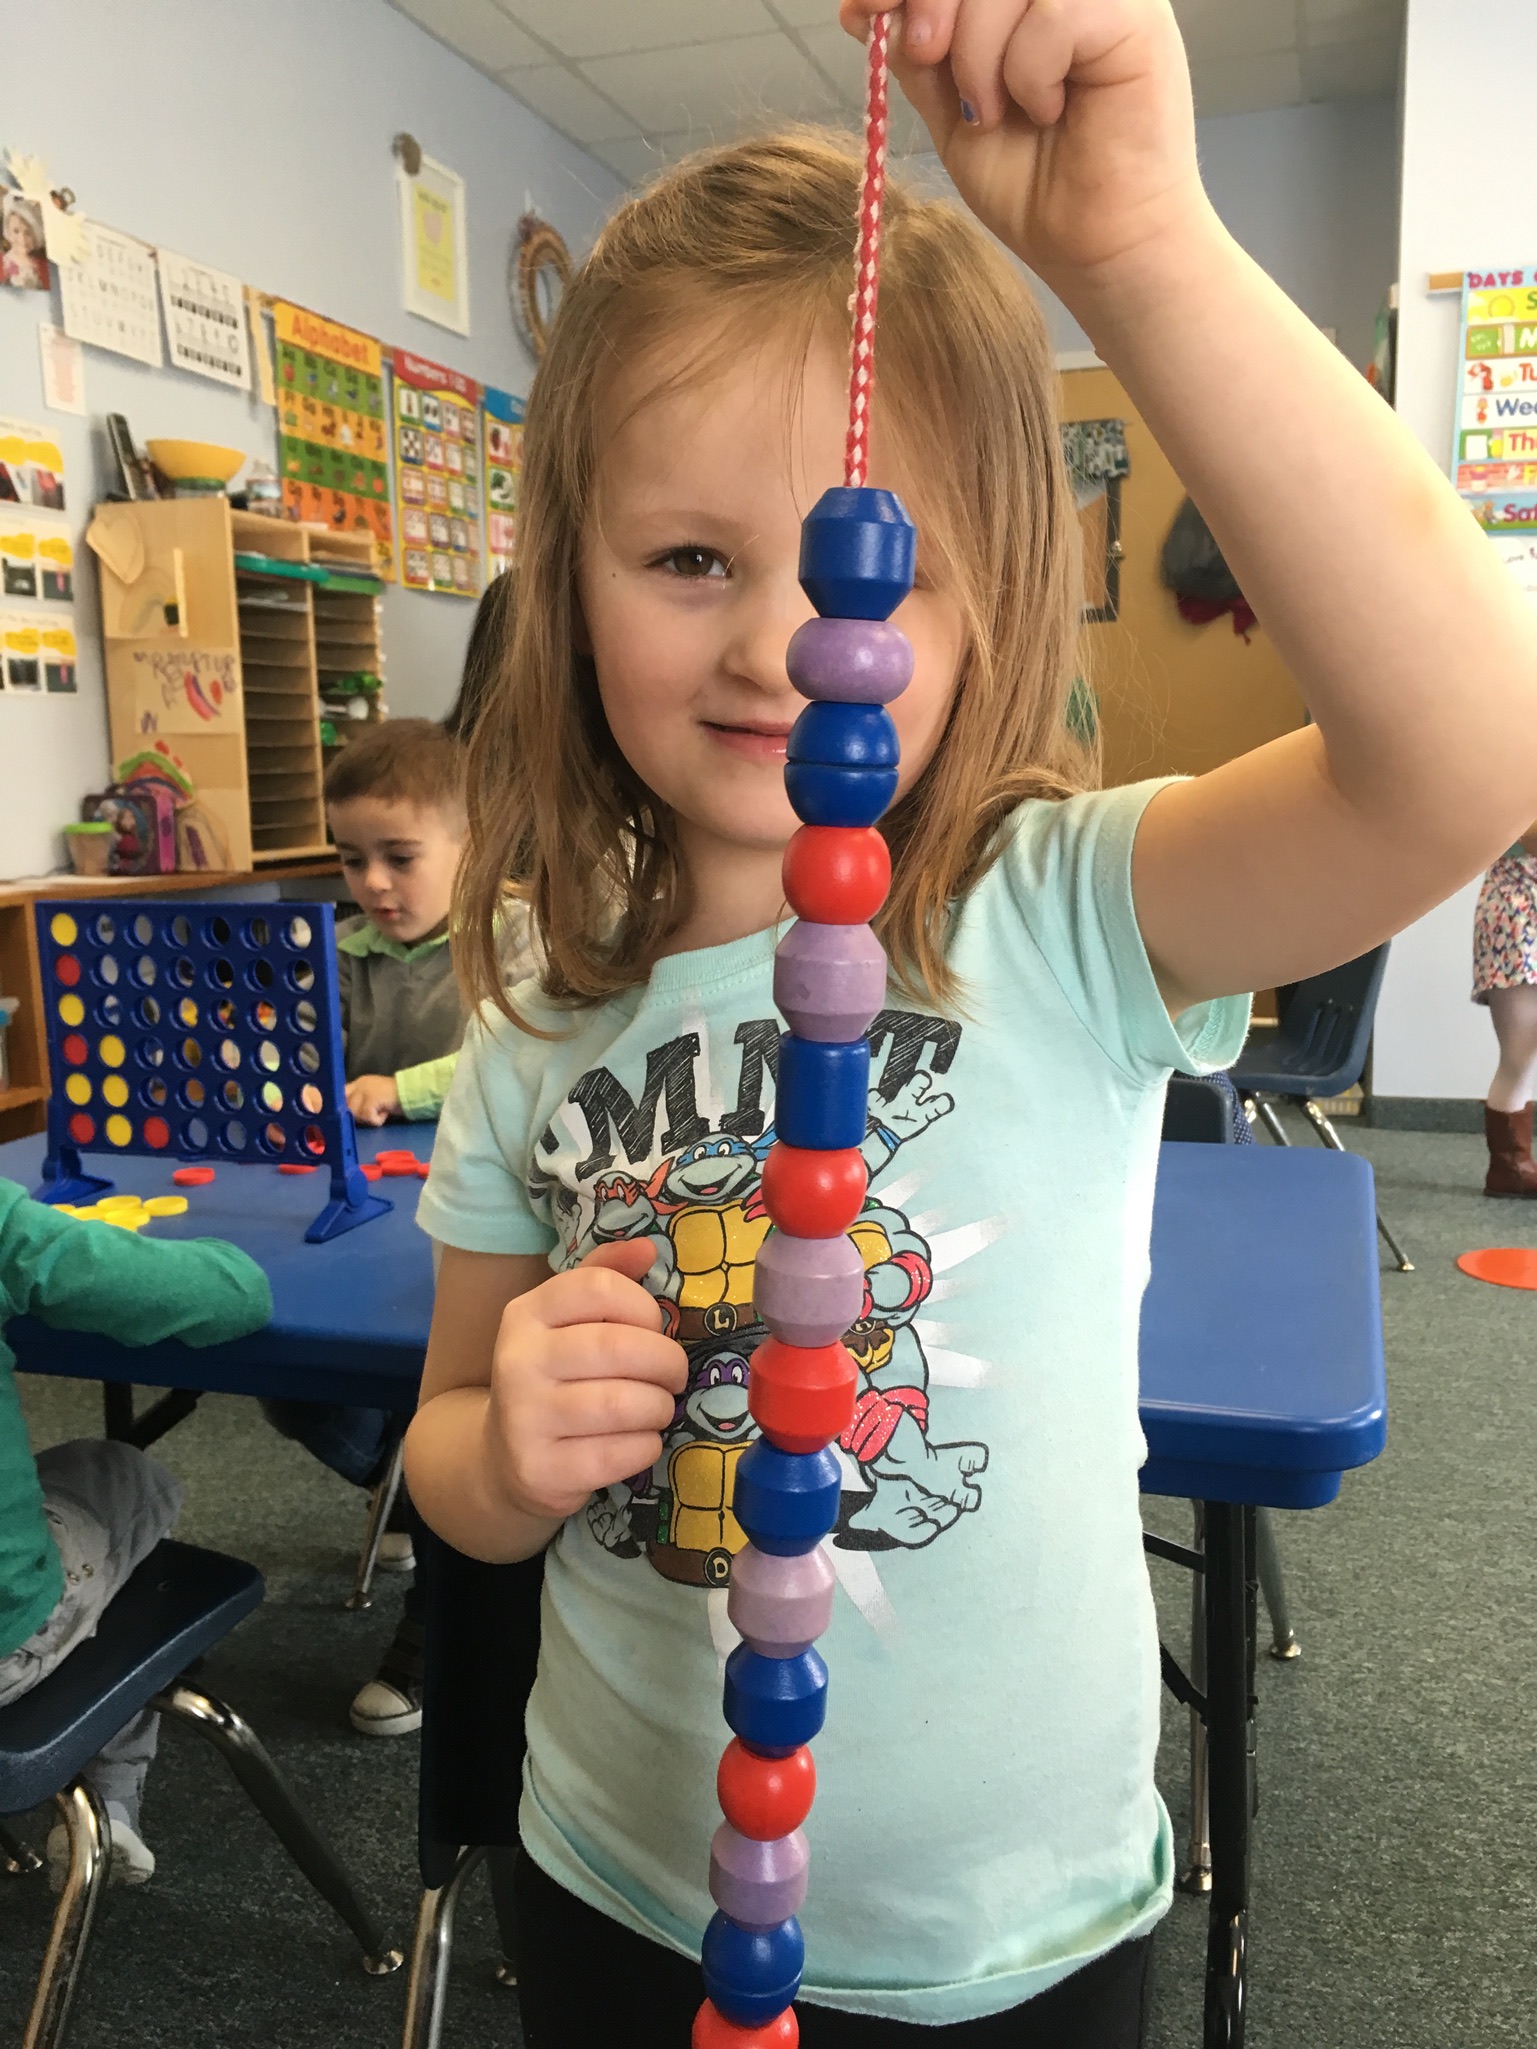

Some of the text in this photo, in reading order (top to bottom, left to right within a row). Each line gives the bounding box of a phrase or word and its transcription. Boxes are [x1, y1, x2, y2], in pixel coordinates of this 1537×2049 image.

[1468, 270, 1524, 289] DAYS
[713, 1309, 730, 1330] L
[712, 1556, 729, 1579] D
